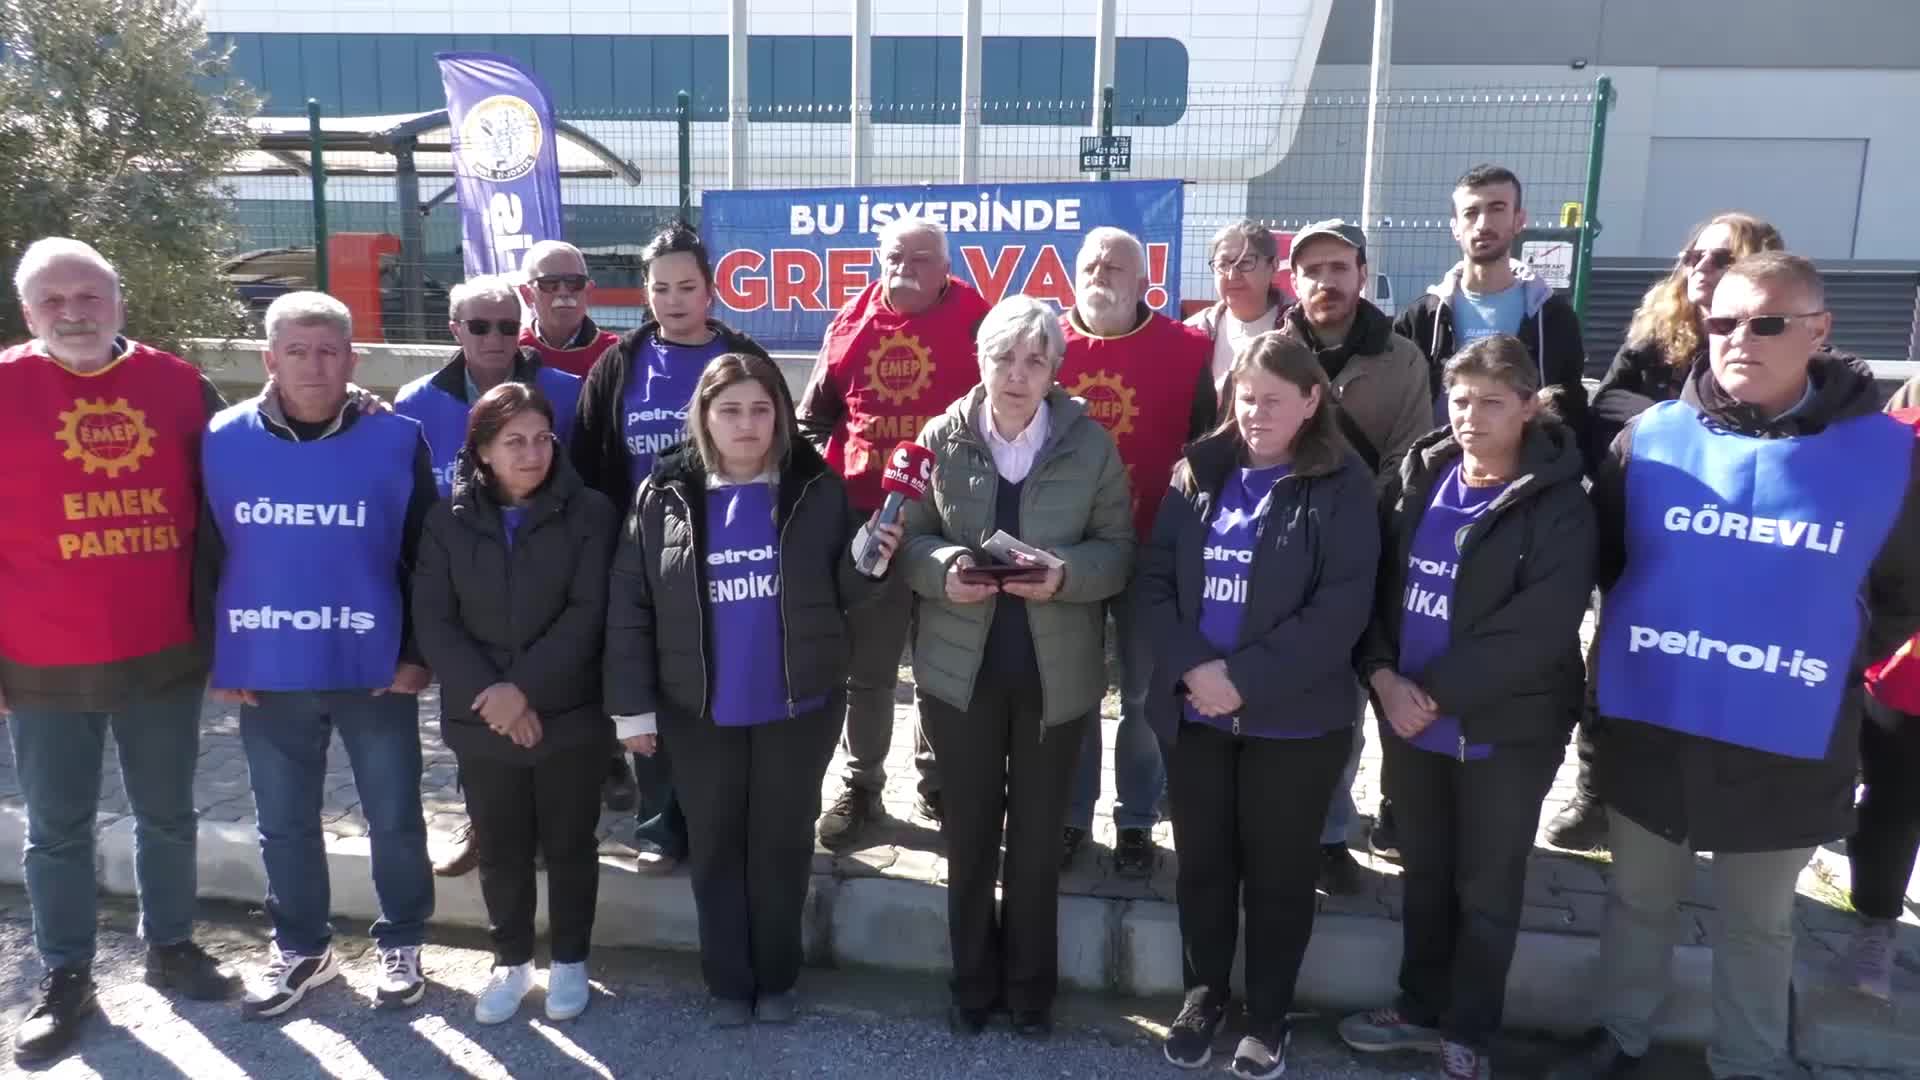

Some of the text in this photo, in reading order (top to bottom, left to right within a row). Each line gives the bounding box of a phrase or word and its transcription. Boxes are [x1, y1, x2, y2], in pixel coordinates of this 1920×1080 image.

[1084, 155, 1105, 166] EGE
[790, 203, 845, 236] BU
[714, 248, 882, 312] GRE
[880, 359, 921, 377] EMEP
[1087, 400, 1121, 417] MEP
[79, 423, 137, 443] EMEP
[62, 487, 168, 521] EMEK
[234, 497, 367, 528] GÖREVLİ
[58, 517, 181, 560] PARTİSİ
[1663, 503, 1846, 554] GÖREVLİ
[227, 605, 376, 634] petrol-iş
[1629, 625, 1830, 688] petrol-iş
